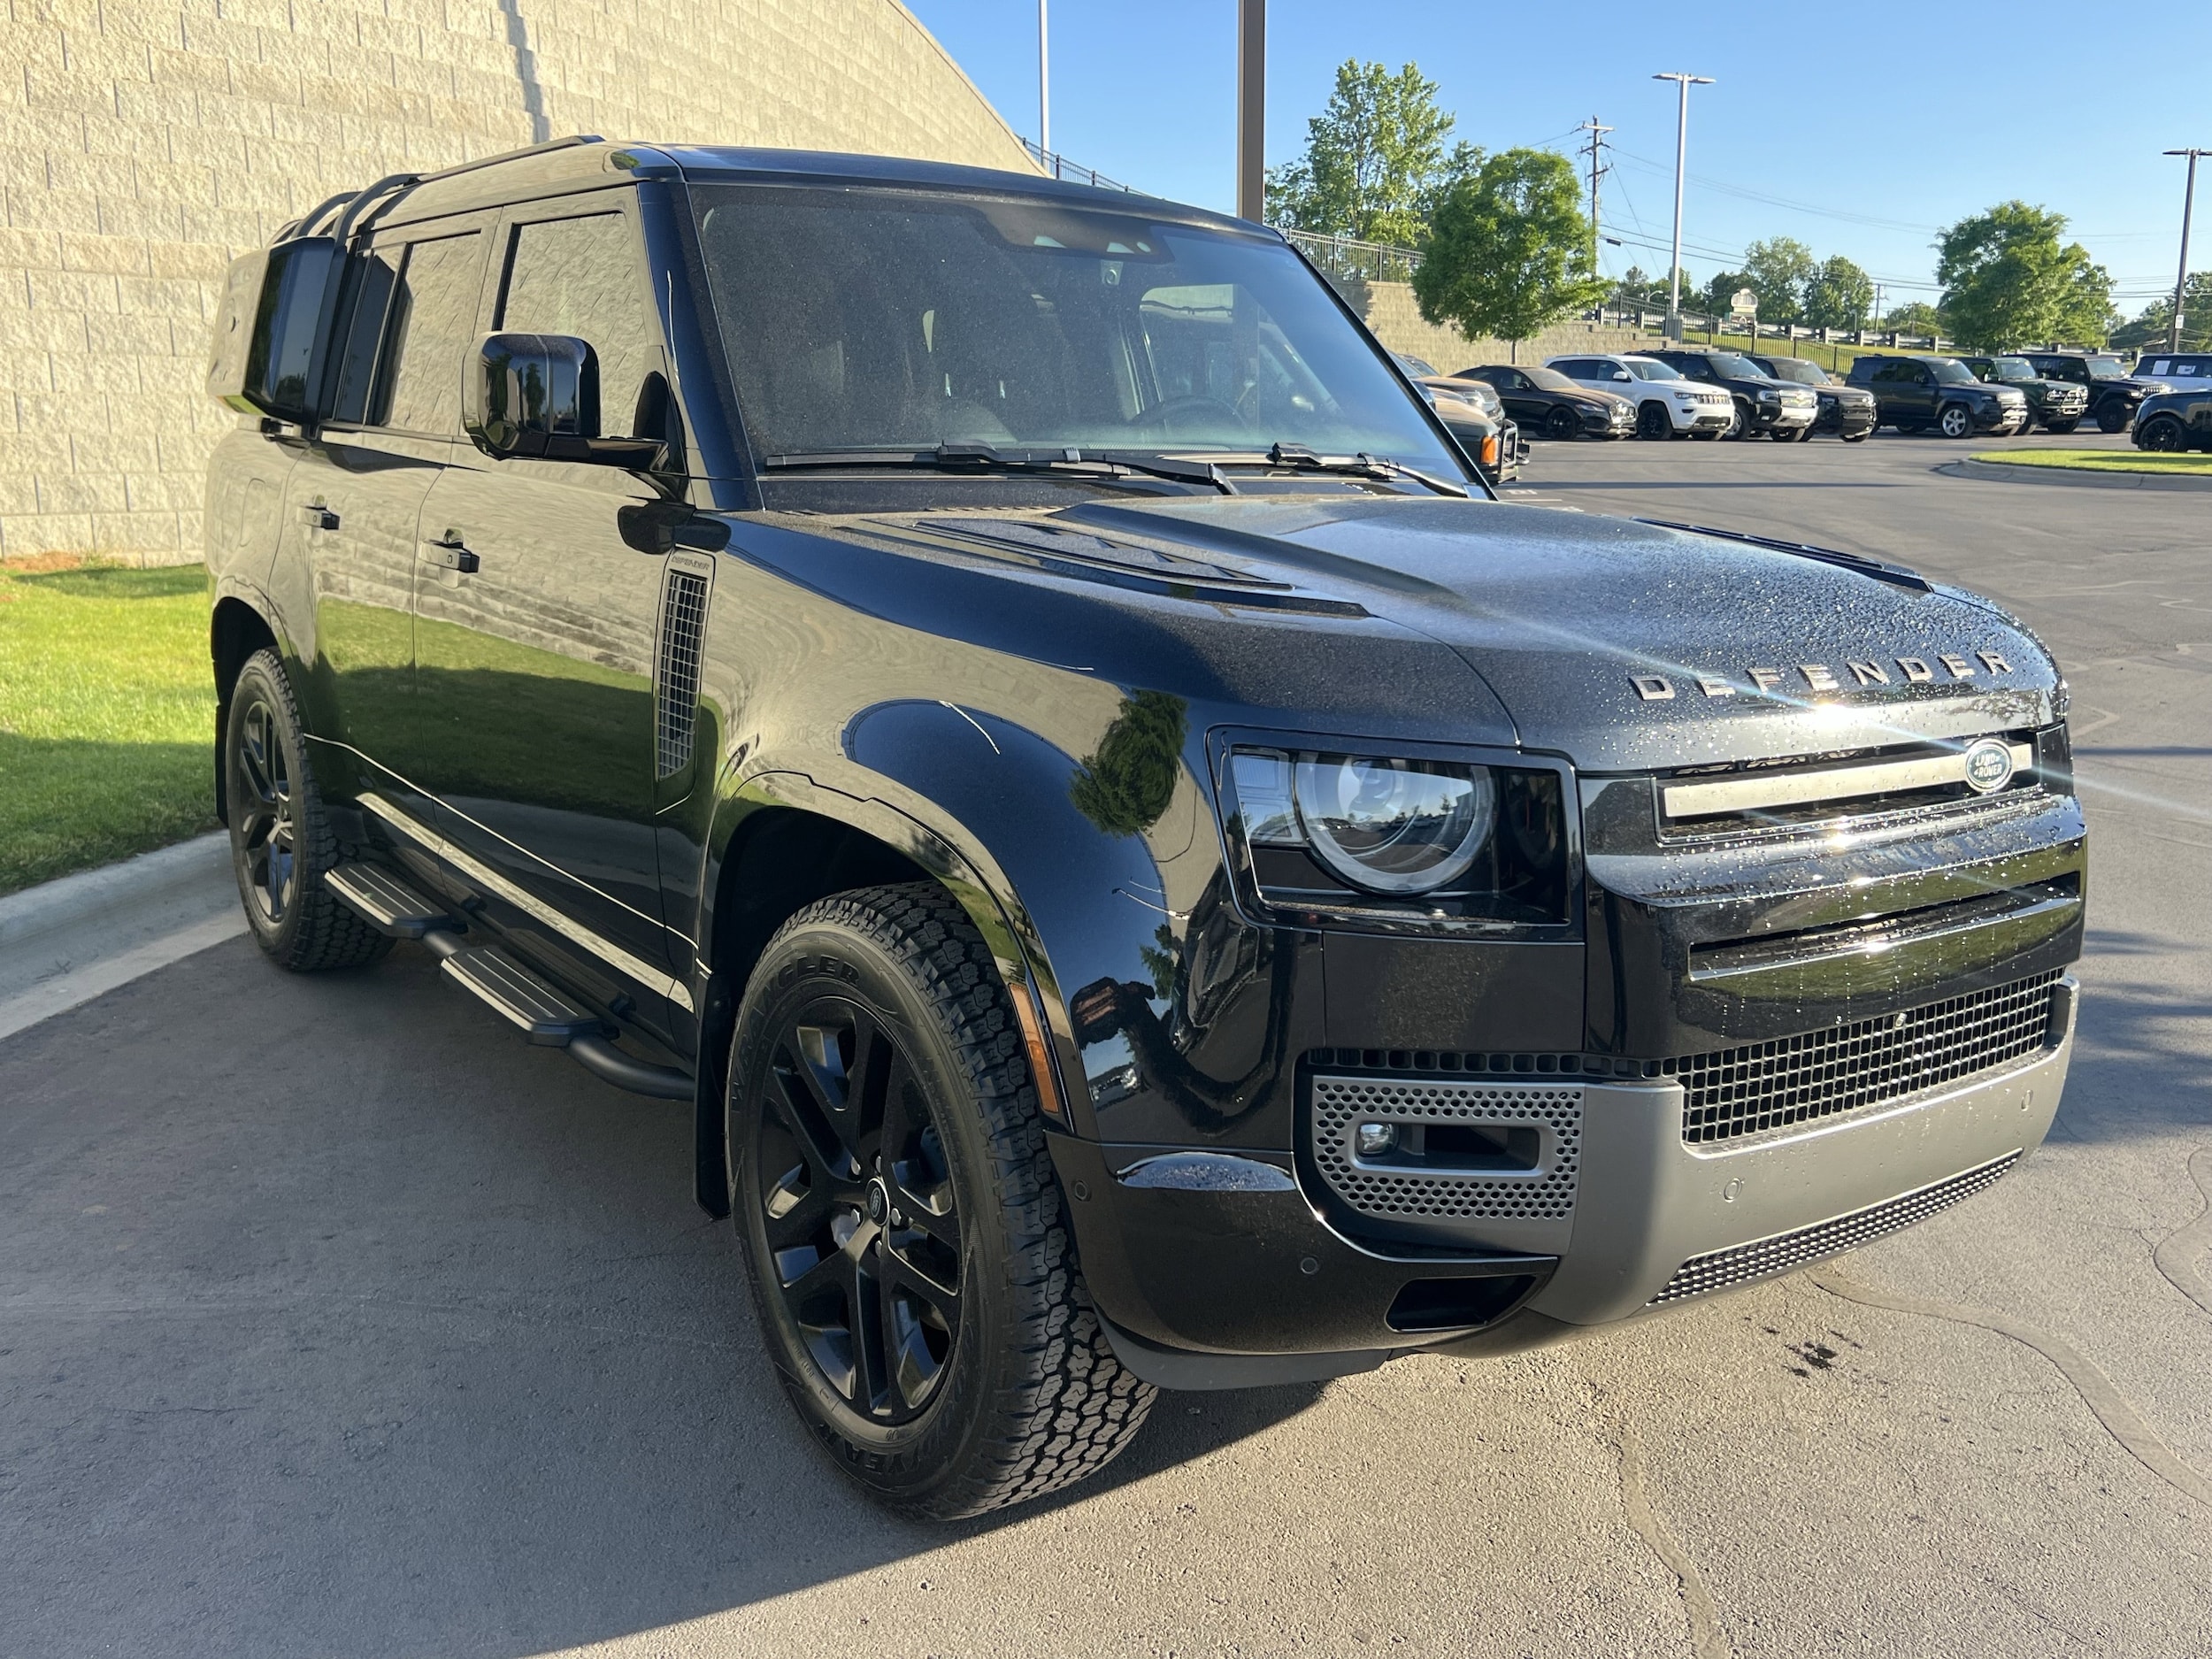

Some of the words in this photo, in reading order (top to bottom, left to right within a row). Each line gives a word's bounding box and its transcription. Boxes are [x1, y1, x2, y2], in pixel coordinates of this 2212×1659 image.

[672, 556, 710, 571] DEFENDER
[1629, 650, 2014, 702] DEFENDER
[1975, 753, 1996, 767] LAND
[1978, 764, 2002, 778] ROVER
